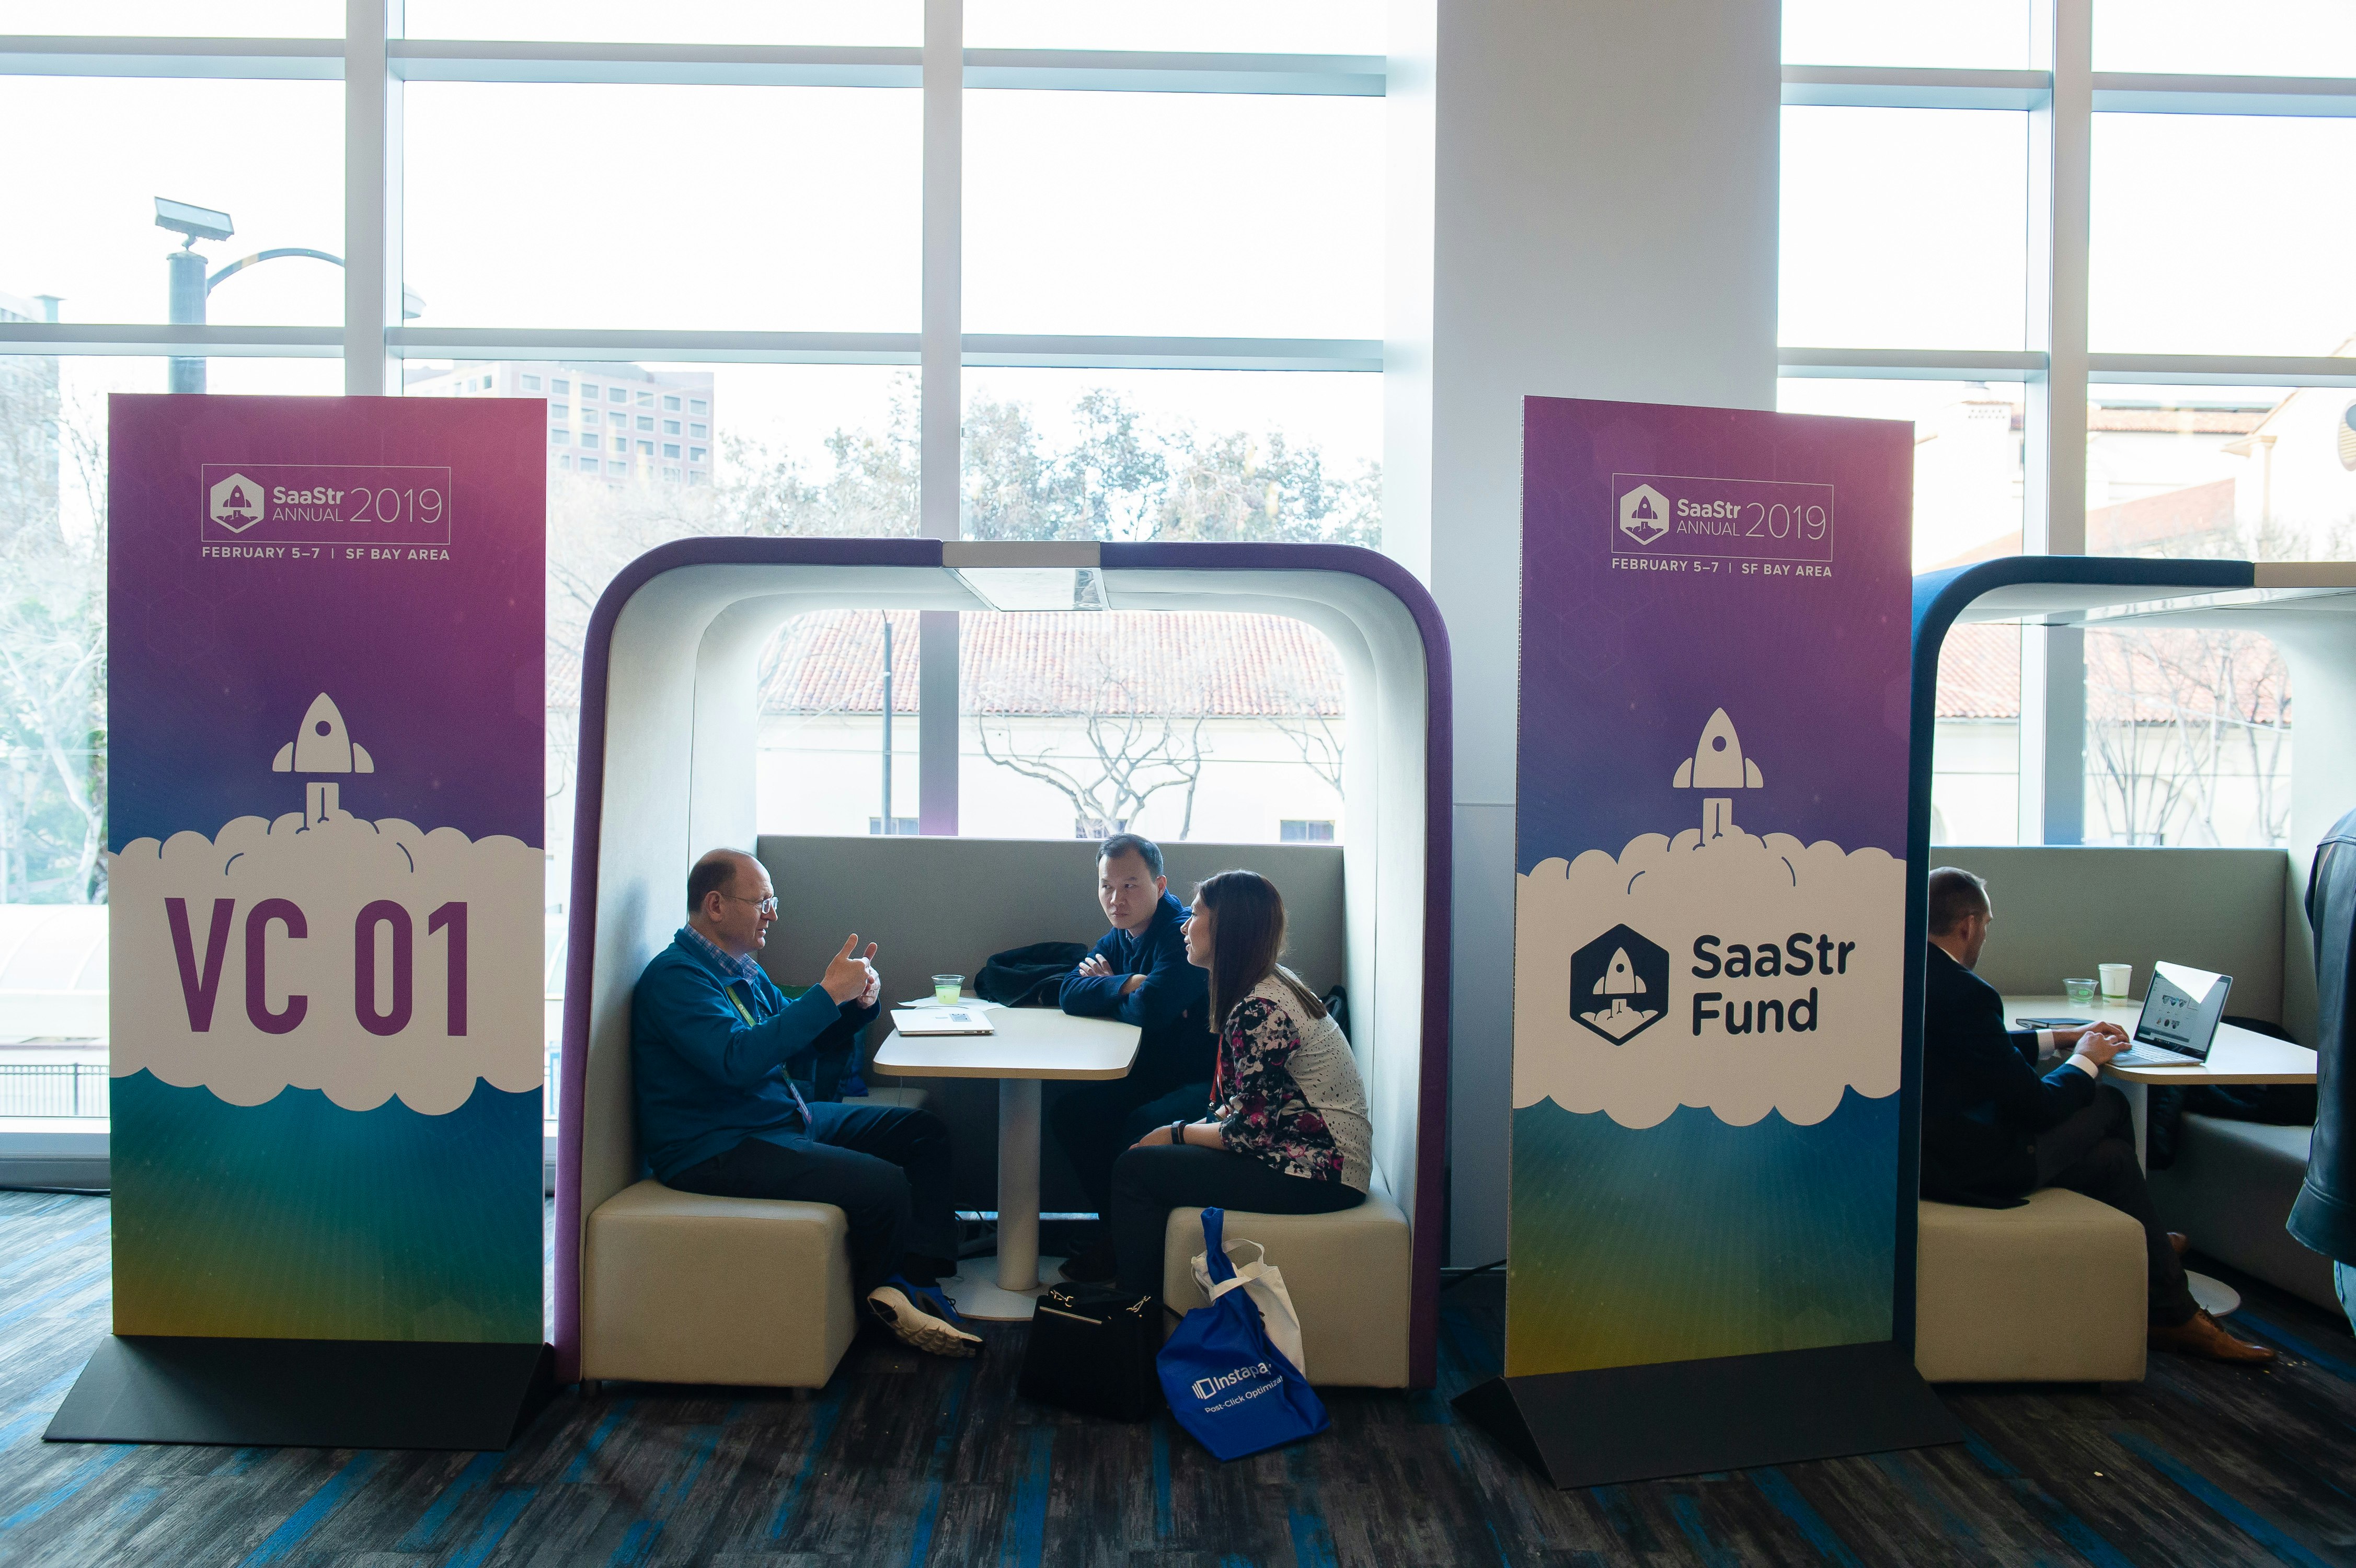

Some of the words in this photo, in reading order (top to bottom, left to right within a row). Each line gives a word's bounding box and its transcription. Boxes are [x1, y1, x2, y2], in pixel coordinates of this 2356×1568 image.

[272, 508, 344, 522] ANNUAL
[350, 487, 442, 523] 2019
[273, 486, 344, 505] SaaStr
[1677, 499, 1741, 518] SaaStr
[1676, 520, 1740, 536] ANNUAL
[1745, 502, 1826, 540] 2019
[202, 546, 285, 558] FEBRUARY
[346, 548, 364, 559] SF
[371, 548, 401, 560] BAY
[407, 549, 450, 560] AREA
[1612, 558, 1688, 571] FEBRUARY
[1742, 563, 1758, 574] SF
[1764, 564, 1790, 575] BAY
[1795, 565, 1832, 577] AREA
[164, 897, 308, 1035] VC
[354, 900, 467, 1036] 01
[1691, 932, 1856, 979] SaaStr
[1692, 987, 1818, 1036] Fund
[1213, 1362, 1271, 1390] Instapa
[1204, 1396, 1246, 1413] Post-Click
